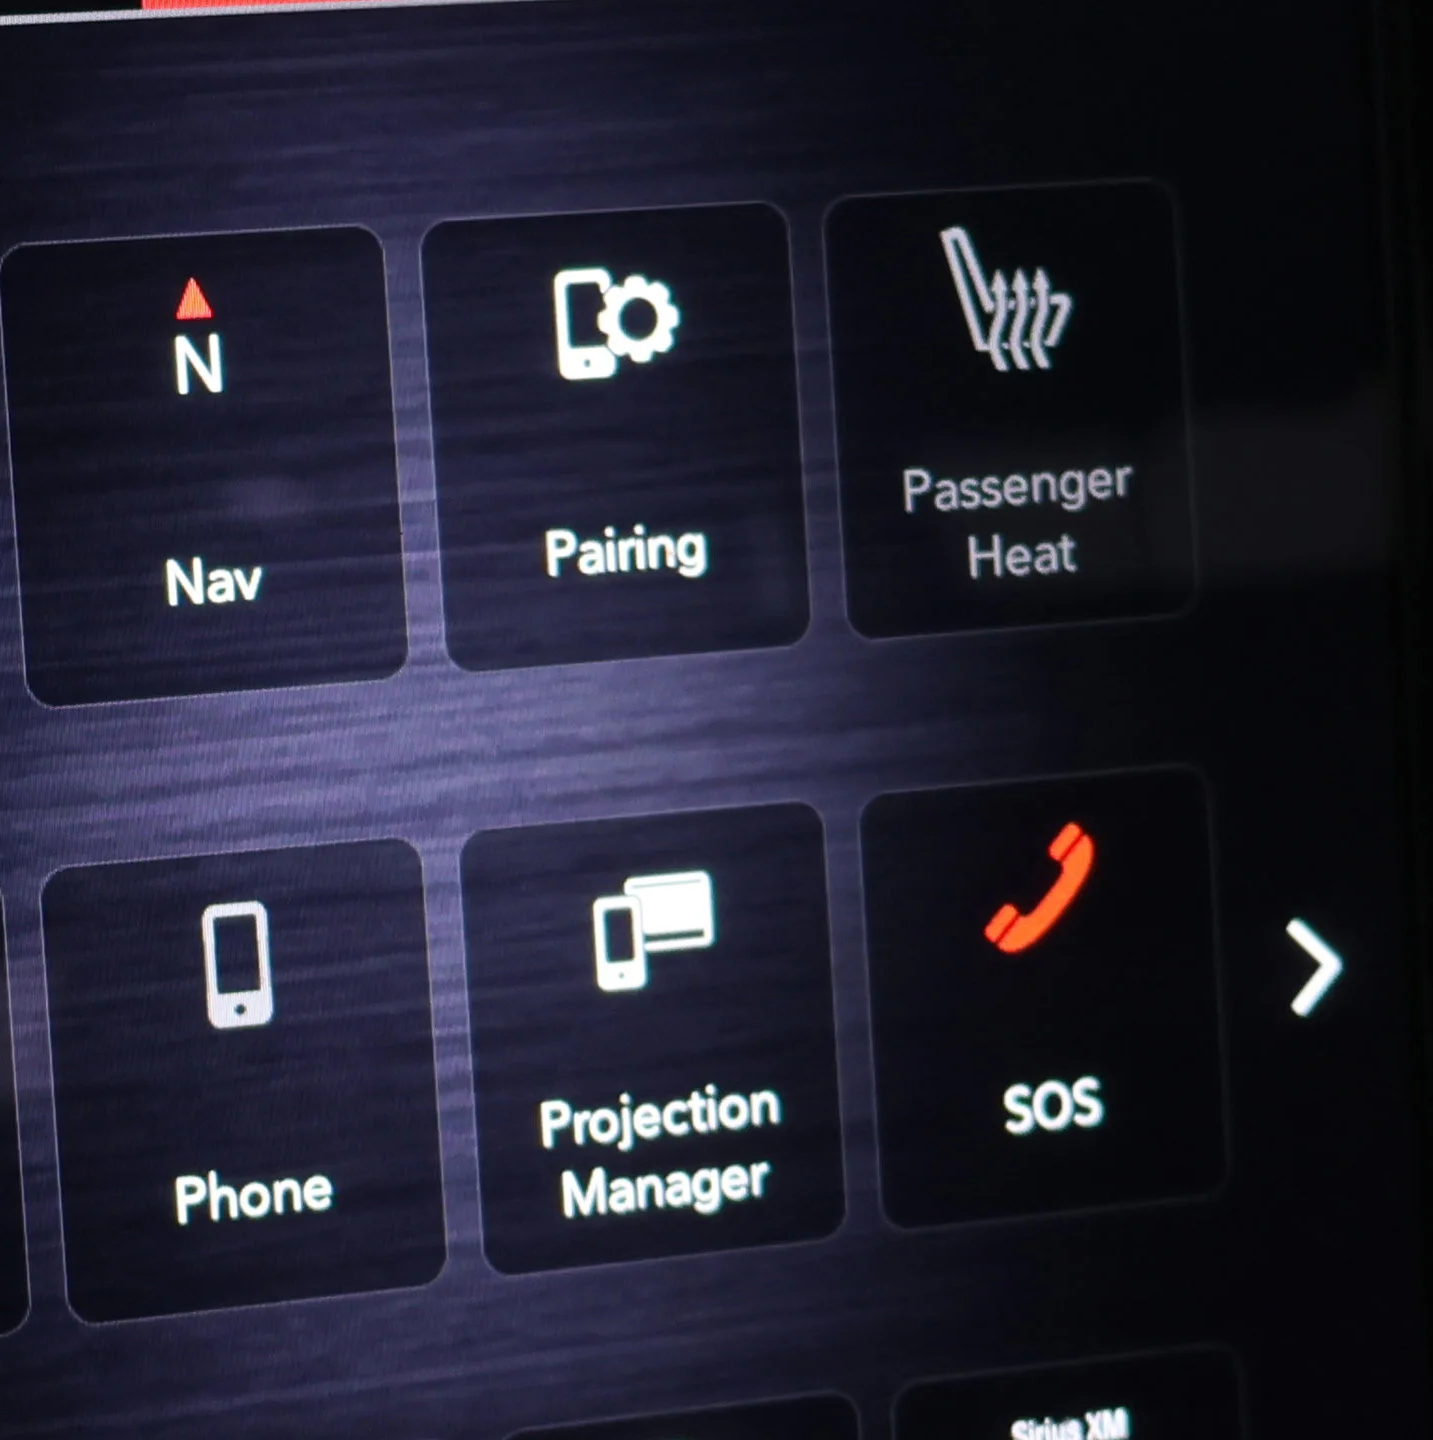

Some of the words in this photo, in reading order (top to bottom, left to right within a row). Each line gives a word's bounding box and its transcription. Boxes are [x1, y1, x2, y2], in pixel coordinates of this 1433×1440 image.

[174, 333, 224, 395] N
[903, 466, 1133, 513] Passenger
[545, 523, 708, 578] Pairing
[967, 533, 1078, 579] Heat
[165, 556, 263, 607] Nav
[540, 1083, 781, 1152] Projection
[1003, 1075, 1104, 1135] SOS
[175, 1169, 334, 1226] Phone
[561, 1161, 771, 1219] Manager
